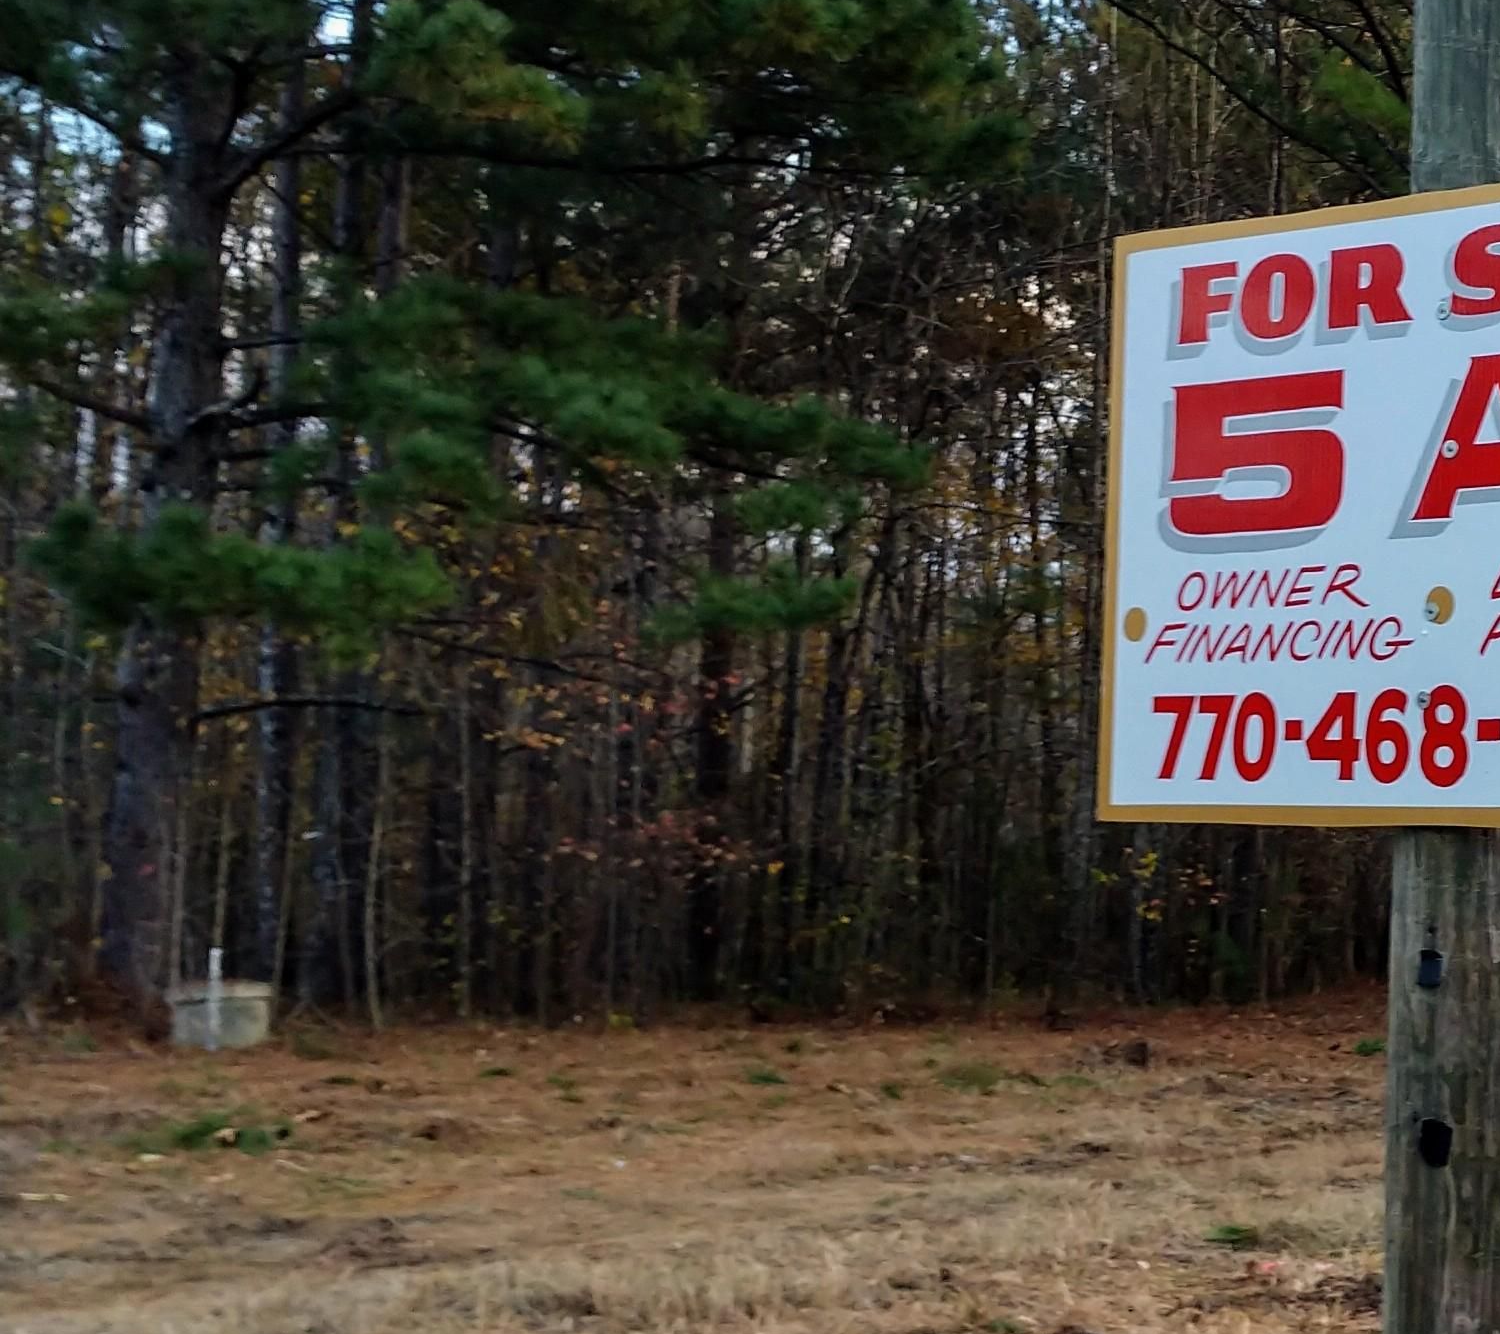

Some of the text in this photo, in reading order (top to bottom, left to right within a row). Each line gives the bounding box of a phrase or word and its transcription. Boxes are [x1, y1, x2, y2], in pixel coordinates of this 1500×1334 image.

[1177, 244, 1413, 346] FOR
[1168, 369, 1345, 536] 5
[1177, 563, 1370, 612] OWNER
[1145, 615, 1414, 664] FINANCING
